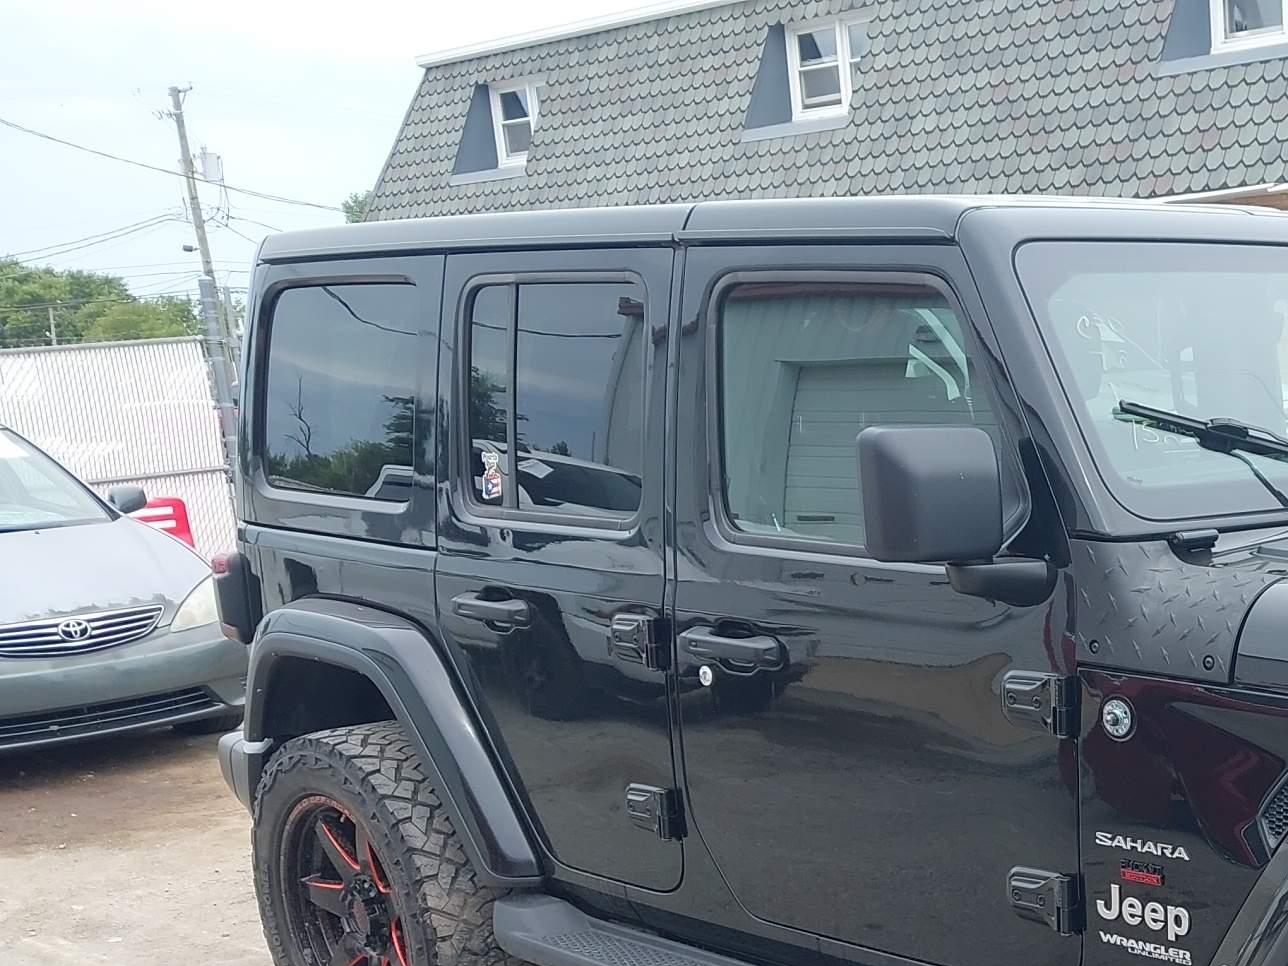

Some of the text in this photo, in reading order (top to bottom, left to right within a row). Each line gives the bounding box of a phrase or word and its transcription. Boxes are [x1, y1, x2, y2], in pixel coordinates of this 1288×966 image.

[1095, 831, 1191, 862] SAHARA
[1096, 884, 1191, 942] Jeep
[1098, 930, 1192, 961] WRANGLER
[1127, 947, 1193, 966] UNLIMITED
